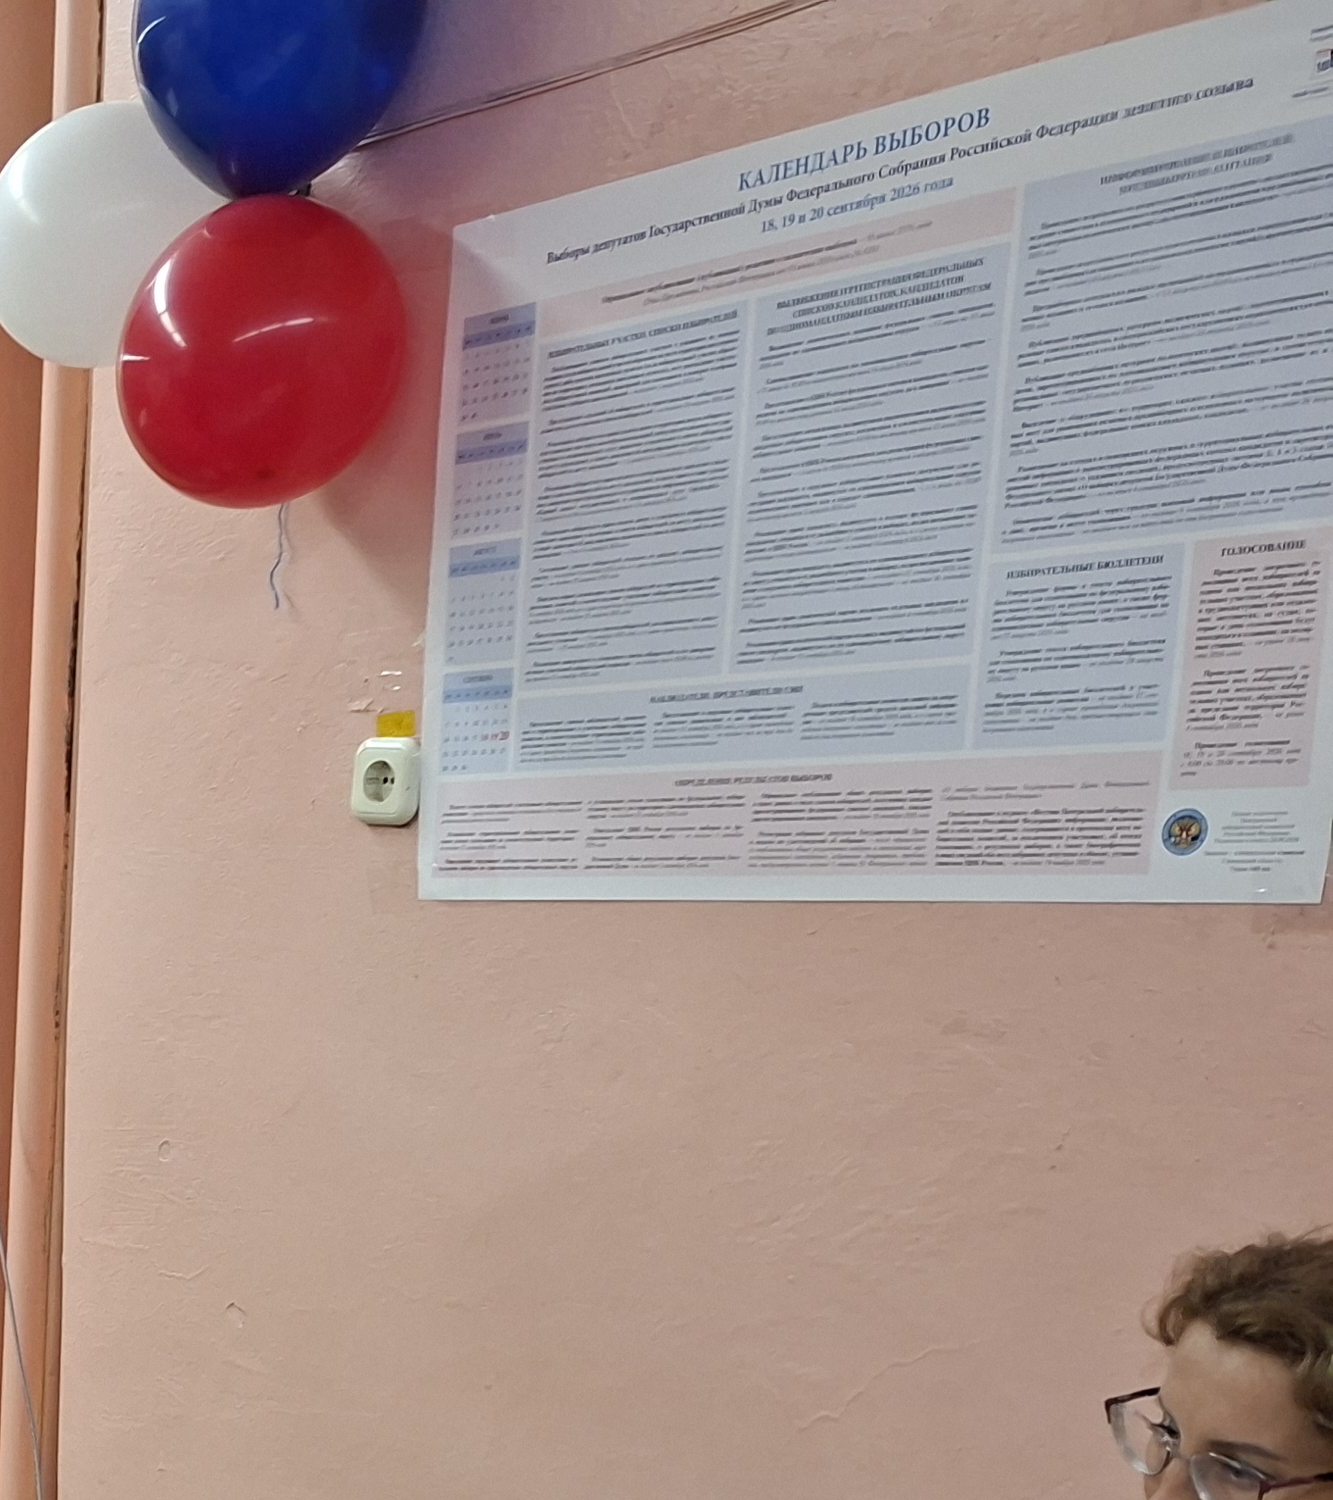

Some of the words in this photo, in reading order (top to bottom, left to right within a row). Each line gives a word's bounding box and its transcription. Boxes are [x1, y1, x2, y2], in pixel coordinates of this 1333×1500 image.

[546, 245, 591, 264] Выборы
[591, 230, 647, 254] депутатов
[649, 203, 746, 238] Государственной
[747, 195, 784, 214] Думы
[786, 172, 875, 202] Федерального
[878, 154, 946, 179] Собрания
[950, 129, 1032, 161] Российской
[1035, 111, 1119, 139] Федерации
[737, 138, 868, 192] КАЛЕНДАРЬ
[873, 107, 992, 162] ВЫБОРОВ
[761, 218, 778, 233] 18,
[782, 213, 796, 228] 19
[808, 205, 825, 222] 20
[826, 193, 886, 217] сентября
[889, 182, 921, 202] 2026
[923, 176, 954, 193] года
